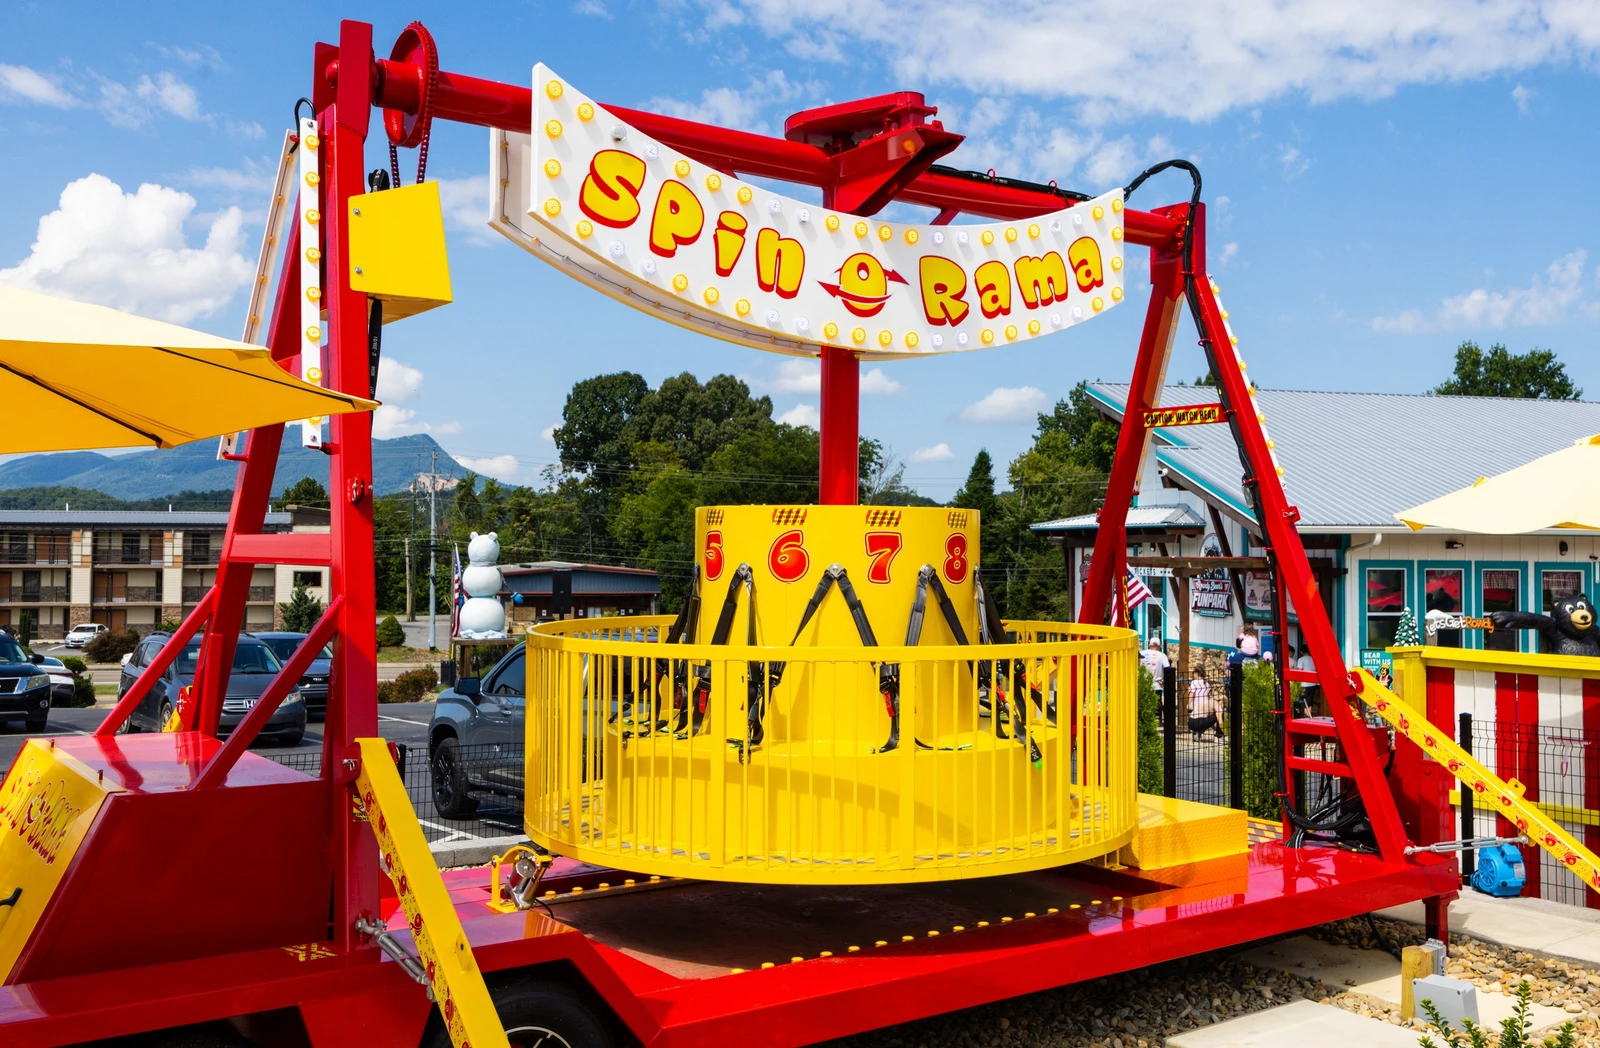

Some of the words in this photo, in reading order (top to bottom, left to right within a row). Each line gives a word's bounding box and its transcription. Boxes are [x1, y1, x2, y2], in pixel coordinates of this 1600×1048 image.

[579, 148, 806, 300] Spin
[835, 251, 891, 318] O
[918, 235, 1103, 328] Rama
[1176, 410, 1198, 422] WATCH
[1199, 408, 1217, 420] HEAD
[705, 529, 724, 582] 5
[767, 529, 810, 584] 6
[864, 531, 903, 585] 7
[943, 532, 968, 585] 8
[1192, 592, 1229, 611] FUNPARK
